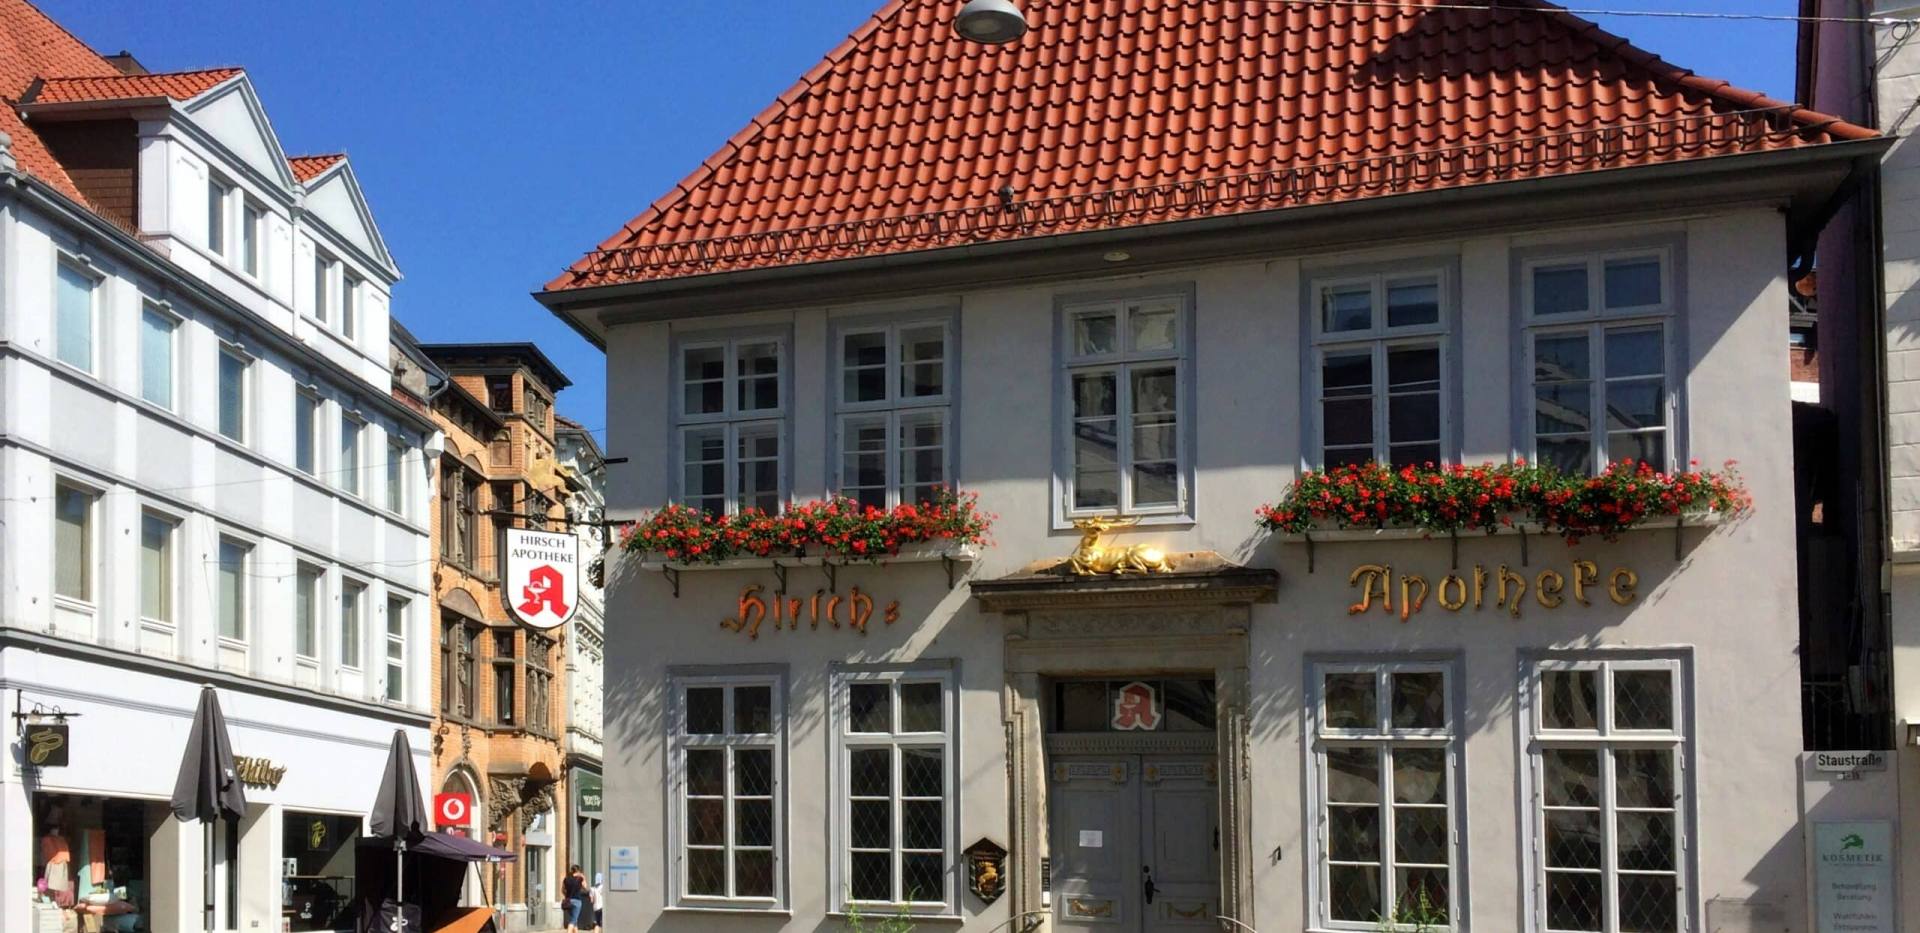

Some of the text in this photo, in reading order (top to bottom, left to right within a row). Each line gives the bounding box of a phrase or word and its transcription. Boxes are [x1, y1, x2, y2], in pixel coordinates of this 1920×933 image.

[520, 535, 565, 549] HIRSCH
[511, 548, 574, 563] APOTHEKE
[1348, 559, 1638, 623] Apotheke
[1818, 754, 1882, 766] Staustraße
[1822, 853, 1883, 862] KOSMETIK
